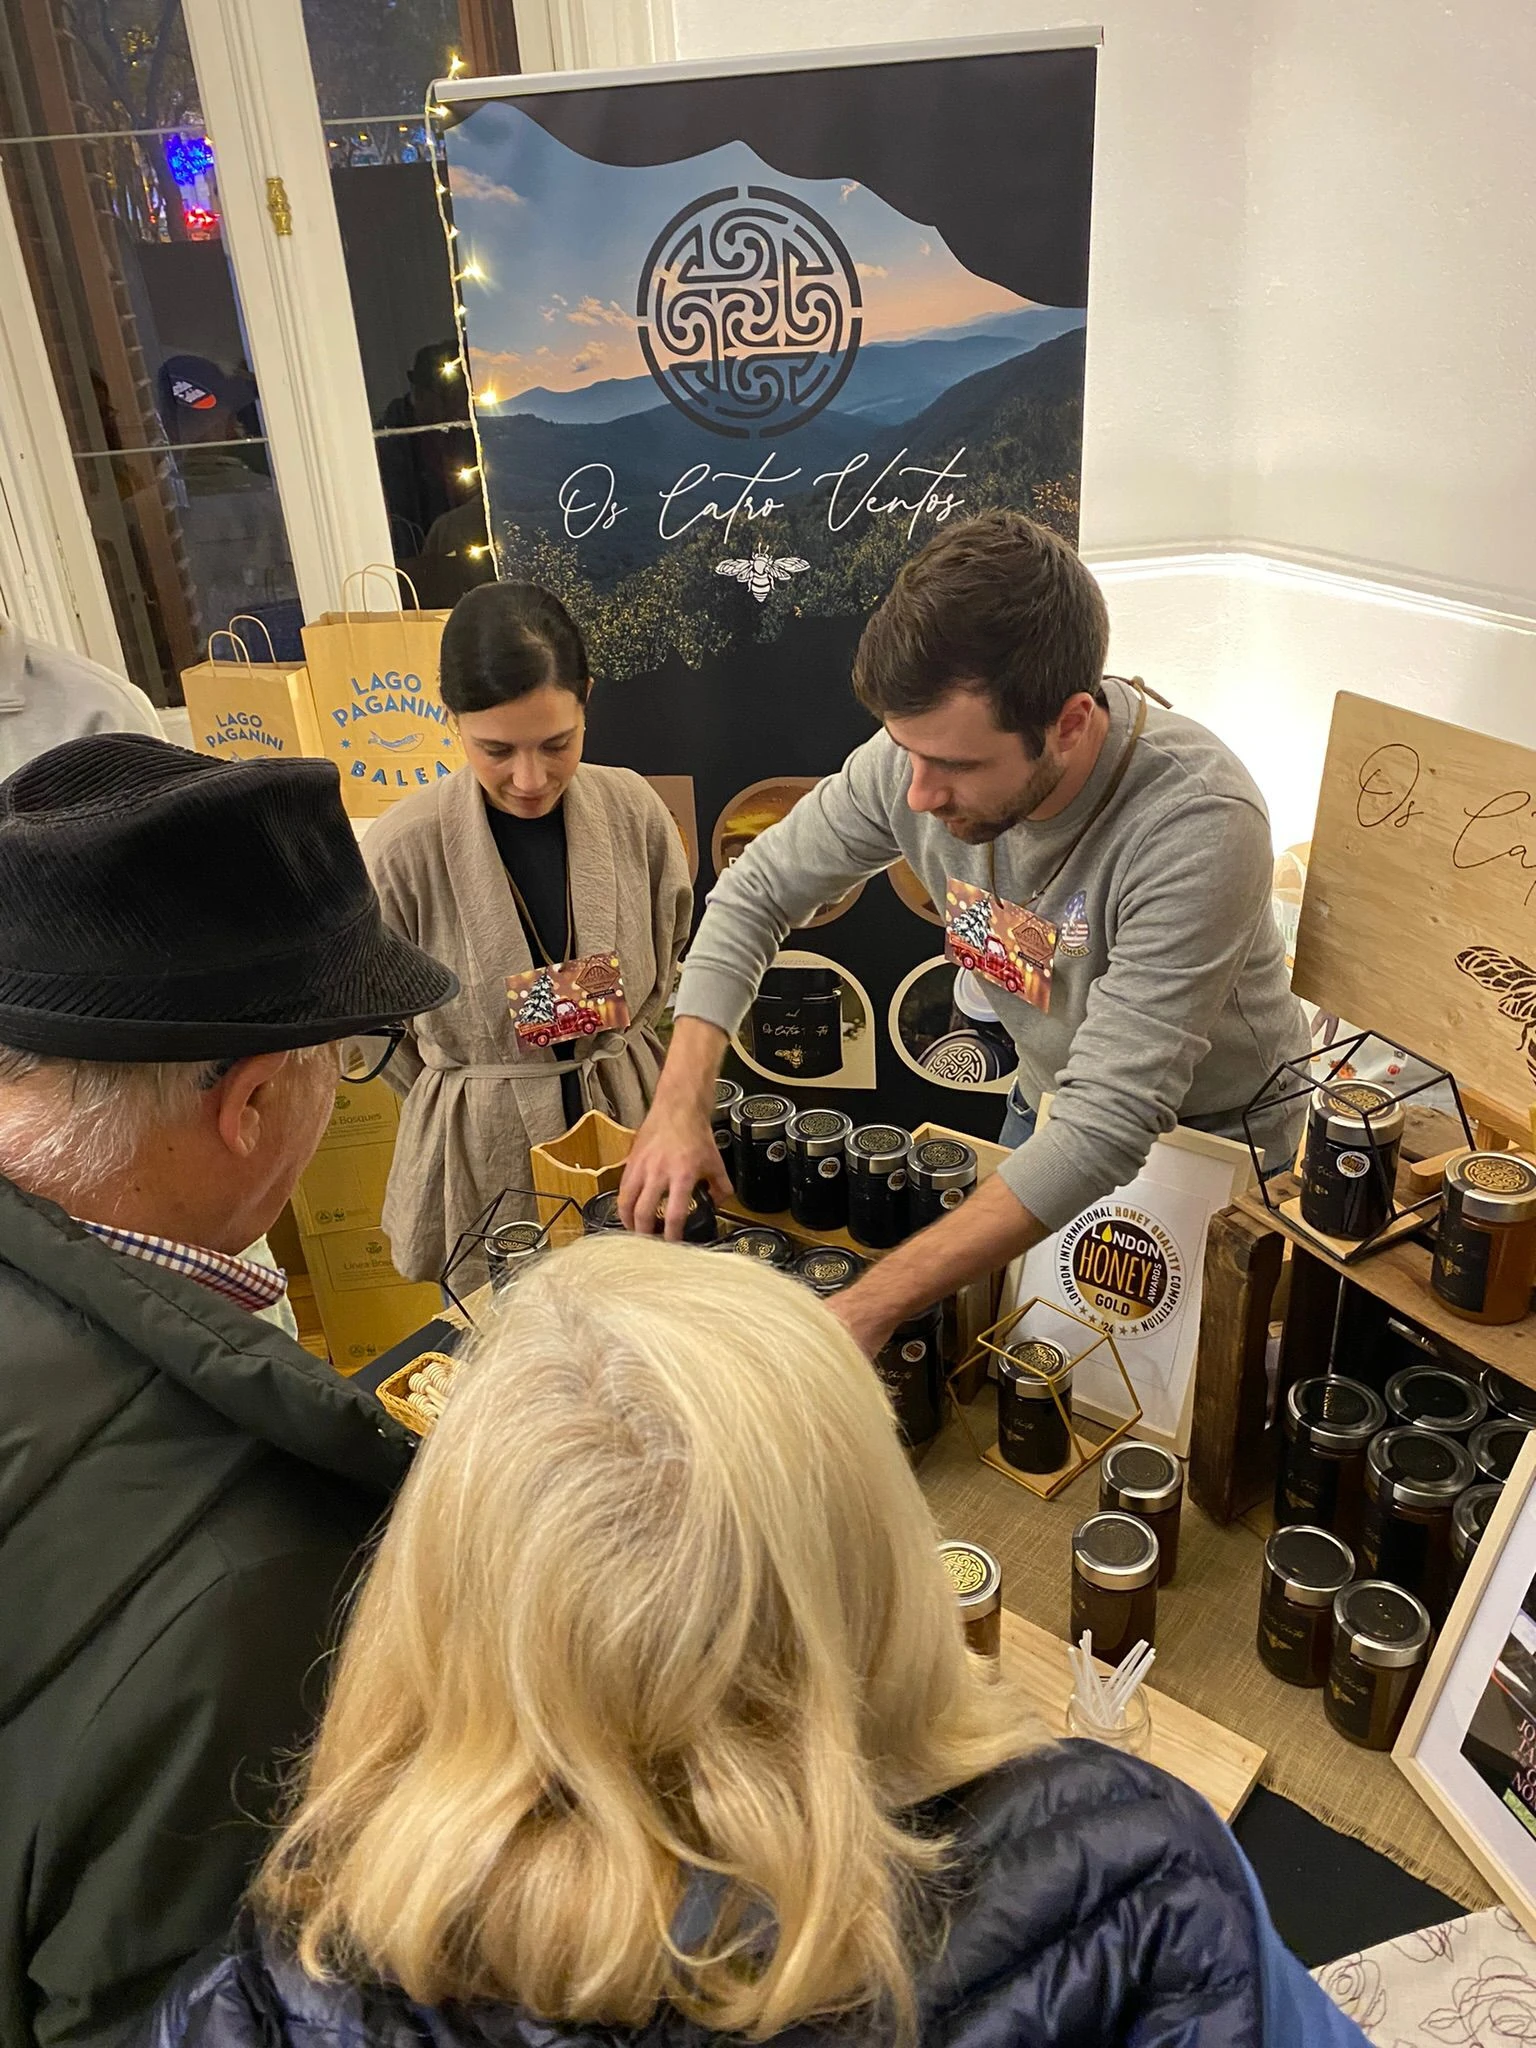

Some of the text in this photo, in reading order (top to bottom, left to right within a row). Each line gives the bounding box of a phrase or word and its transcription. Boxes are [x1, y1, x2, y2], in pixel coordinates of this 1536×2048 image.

[558, 446, 968, 544] Os Catro Ventos
[351, 671, 422, 696] LAGO
[205, 727, 285, 752] PAGANINI
[215, 711, 263, 729] LAGO
[1356, 743, 1425, 829] Os
[1059, 1205, 1182, 1332] LONDON INTERNATIONAL HONEY QUALITY COMPETITION
[1078, 1238, 1153, 1298] HONEY
[1147, 1262, 1163, 1305] AWARDS
[1094, 1293, 1131, 1316] GOLD
